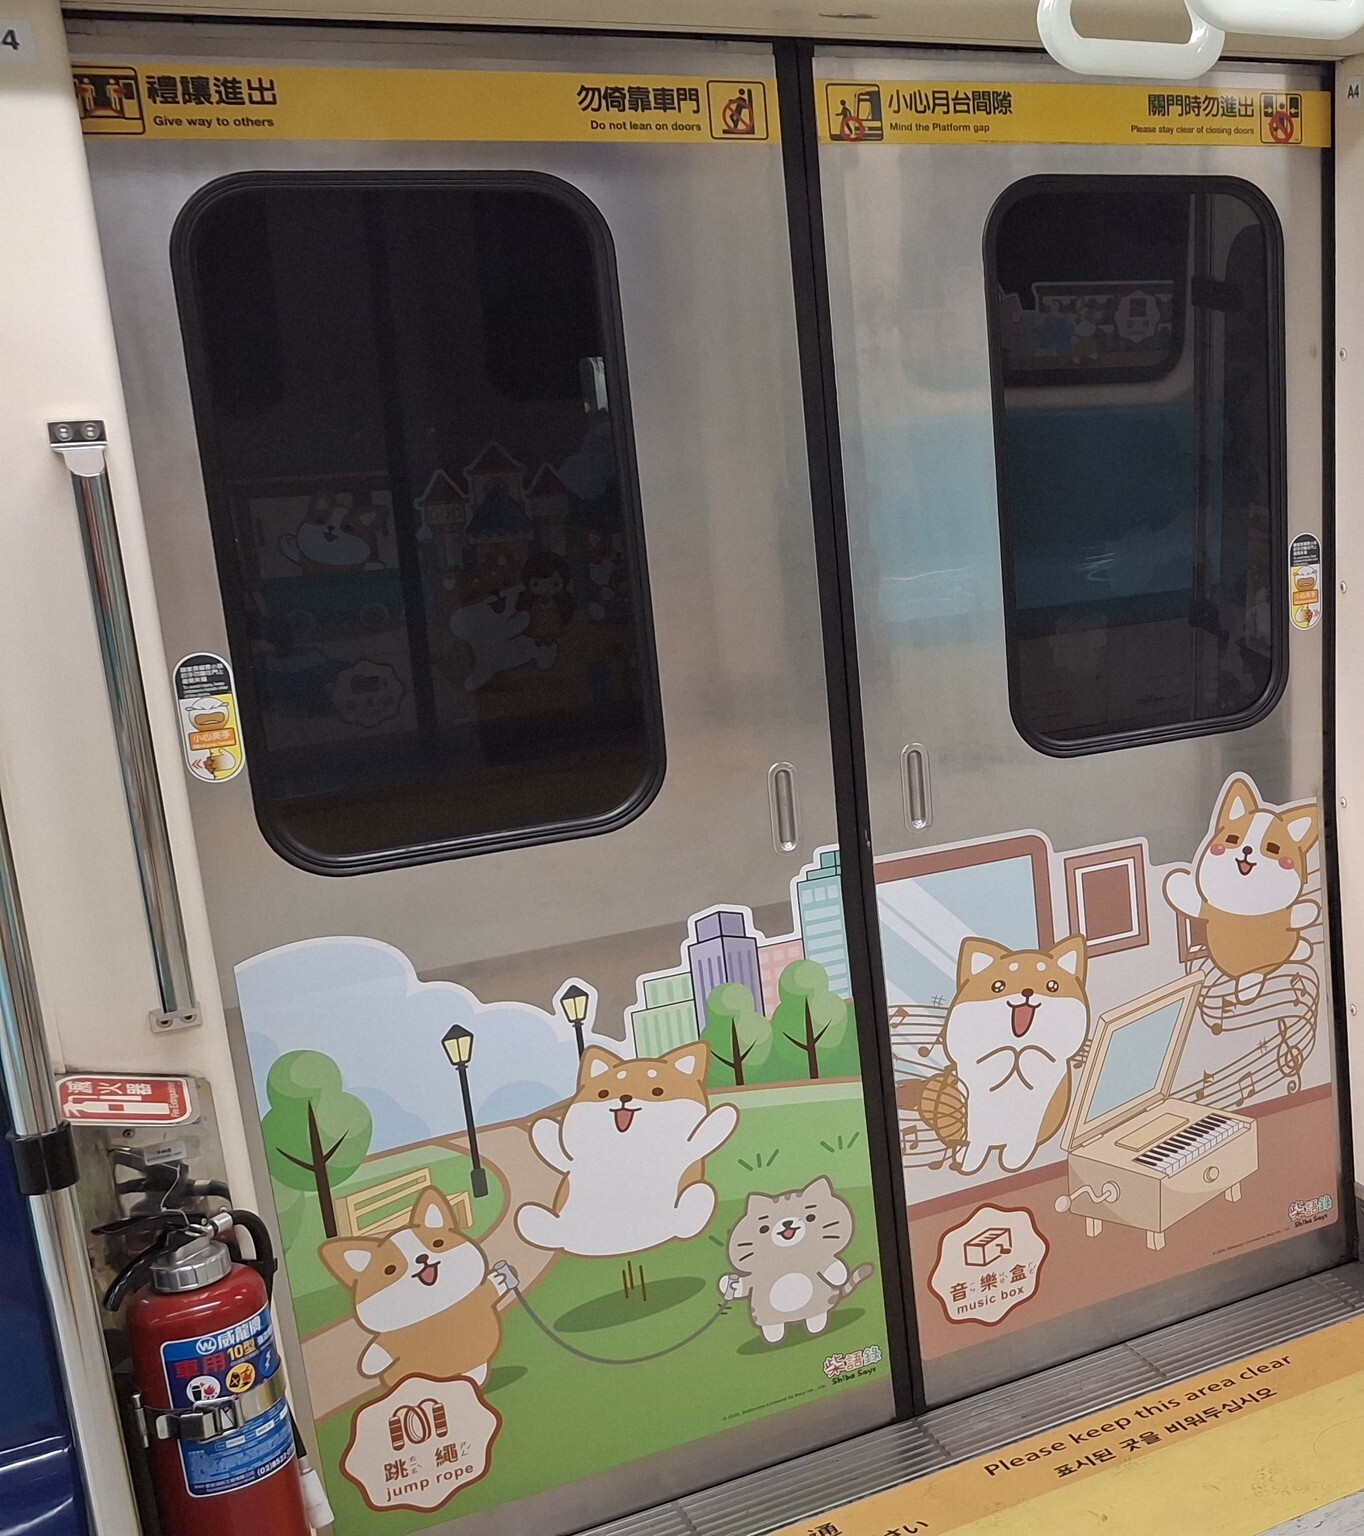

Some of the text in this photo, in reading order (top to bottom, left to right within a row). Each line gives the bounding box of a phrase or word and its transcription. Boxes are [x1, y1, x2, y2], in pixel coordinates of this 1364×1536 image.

[0, 29, 20, 50] 4
[145, 75, 278, 106] 禮讓進出
[576, 84, 701, 114] 勿倚靠車門
[888, 89, 1013, 116] 小心月台間隙
[1347, 84, 1360, 99] A4
[1147, 93, 1255, 118] 關門時勿進出
[153, 115, 275, 130] Give way to others
[590, 119, 702, 132] Do not lean on doors
[889, 122, 990, 133] Mind the Platform gap
[1130, 124, 1255, 136] Please stay clear of closing doors
[949, 1263, 1028, 1303] 音樂盒
[956, 1286, 1025, 1315] music box
[174, 1352, 227, 1378] 車用
[823, 1345, 883, 1378] 柴語錄
[831, 1366, 877, 1386] Shiba Says
[983, 1354, 1292, 1476] Please keep this area clear
[1053, 1387, 1278, 1478] 표시된 곳을 비워두십시오
[383, 1442, 459, 1483] 跳繩
[386, 1464, 474, 1502] jump rope
